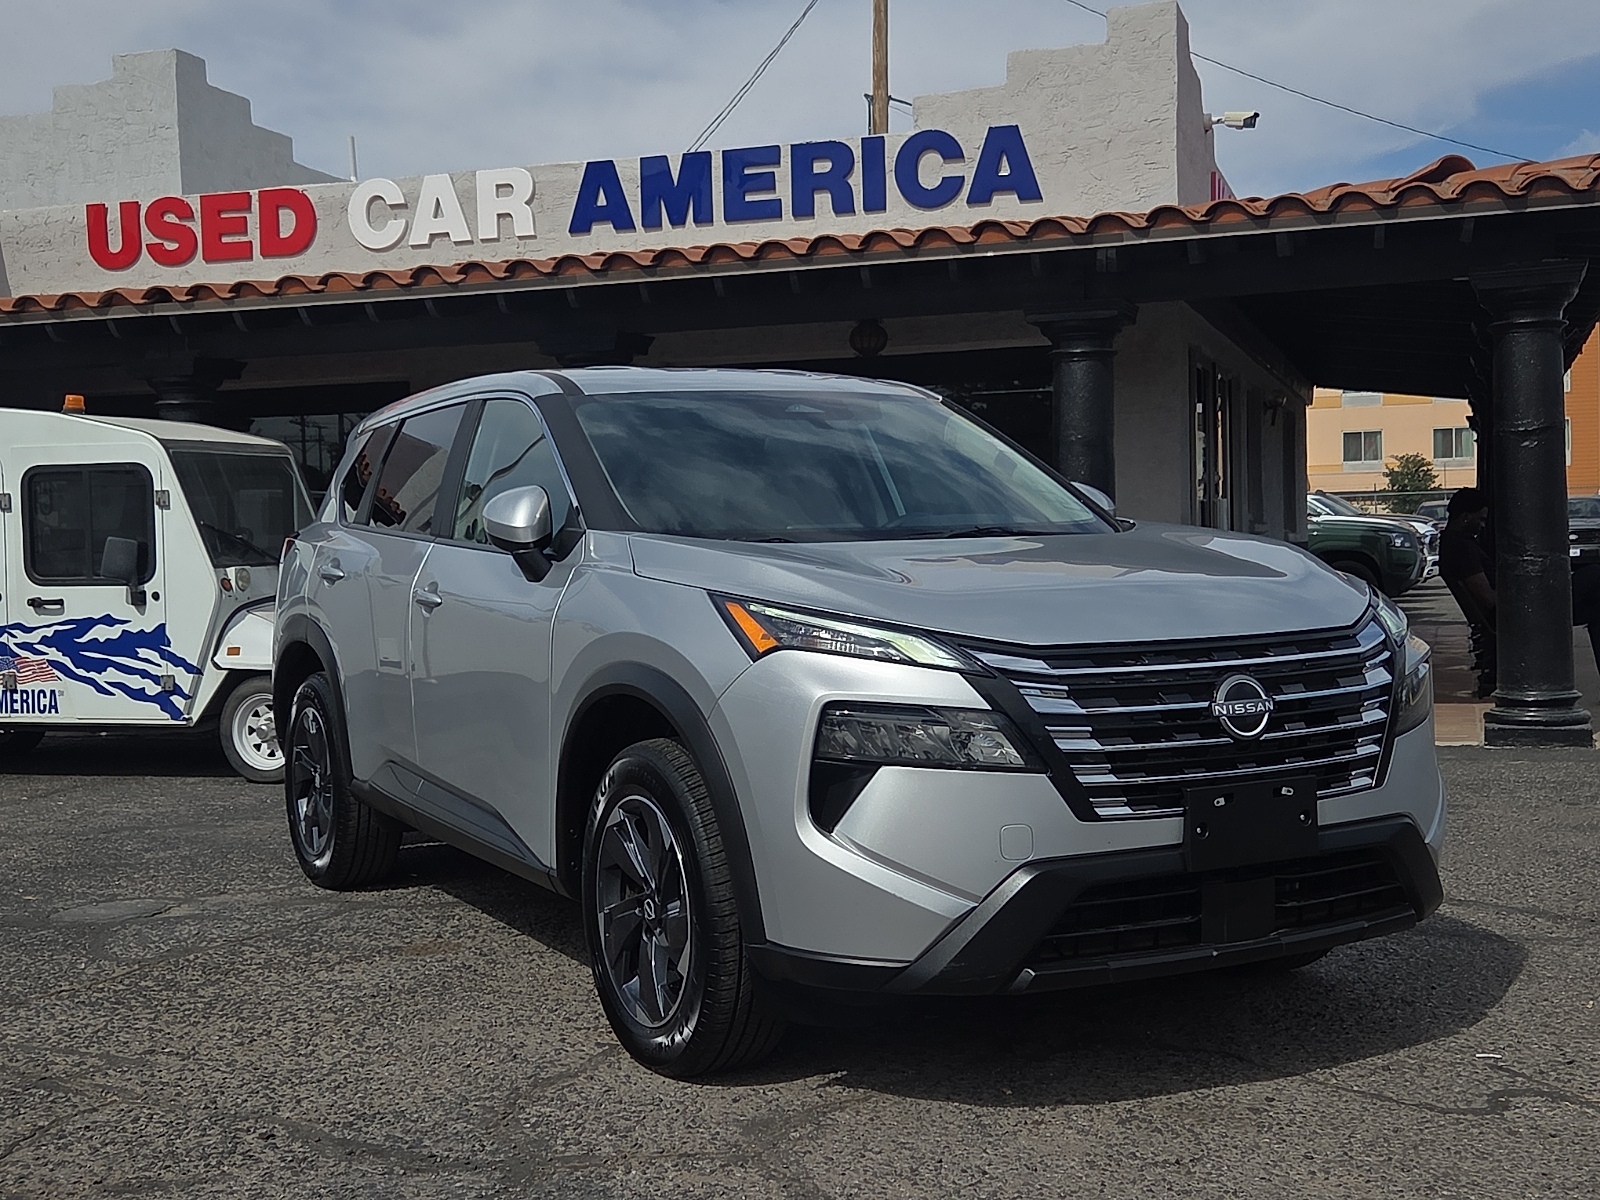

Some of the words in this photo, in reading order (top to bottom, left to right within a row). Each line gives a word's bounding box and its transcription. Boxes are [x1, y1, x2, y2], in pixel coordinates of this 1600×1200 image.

[86, 188, 318, 271] USED
[348, 167, 536, 250] CAR
[568, 125, 1043, 235] AMERICA
[1214, 701, 1273, 715] NISSAN
